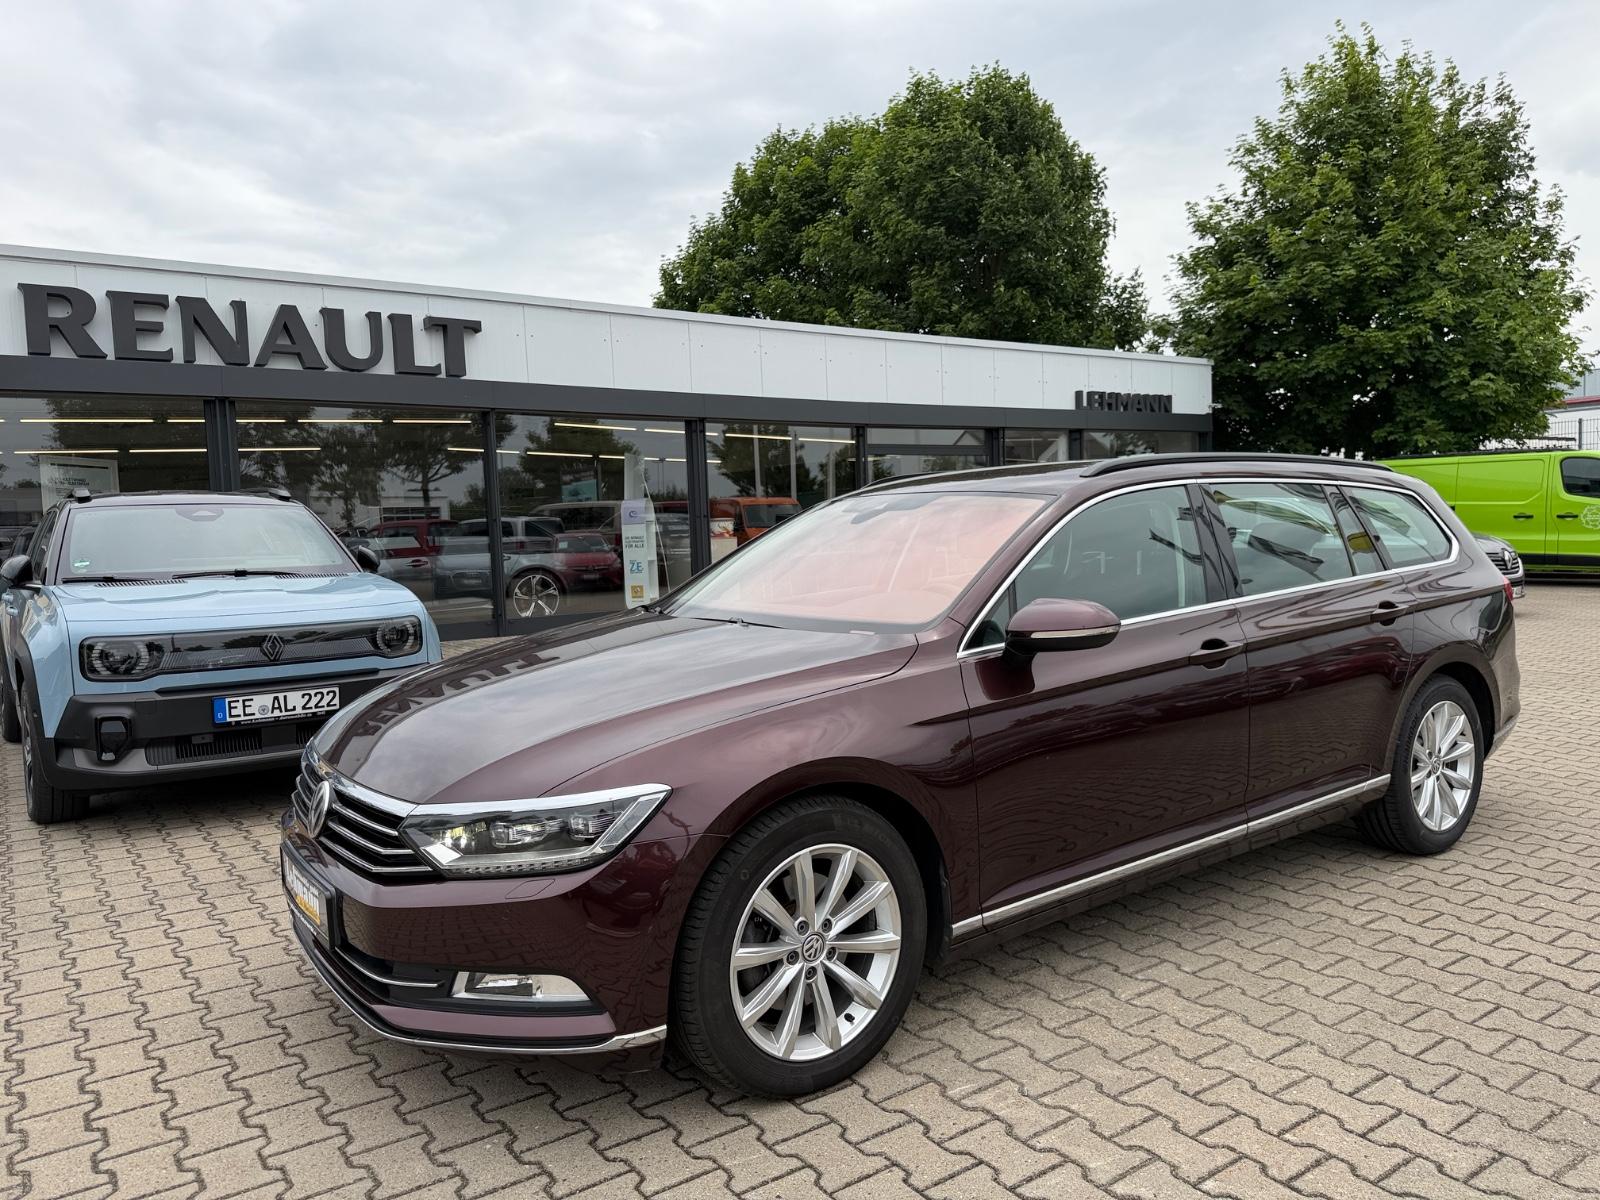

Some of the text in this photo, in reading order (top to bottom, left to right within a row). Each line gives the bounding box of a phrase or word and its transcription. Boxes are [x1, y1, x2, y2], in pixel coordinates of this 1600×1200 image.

[18, 283, 482, 378] RENAULT
[1075, 390, 1172, 413] LEHMANN
[228, 699, 255, 718] EE
[271, 695, 296, 713] AL
[301, 690, 337, 710] 222
